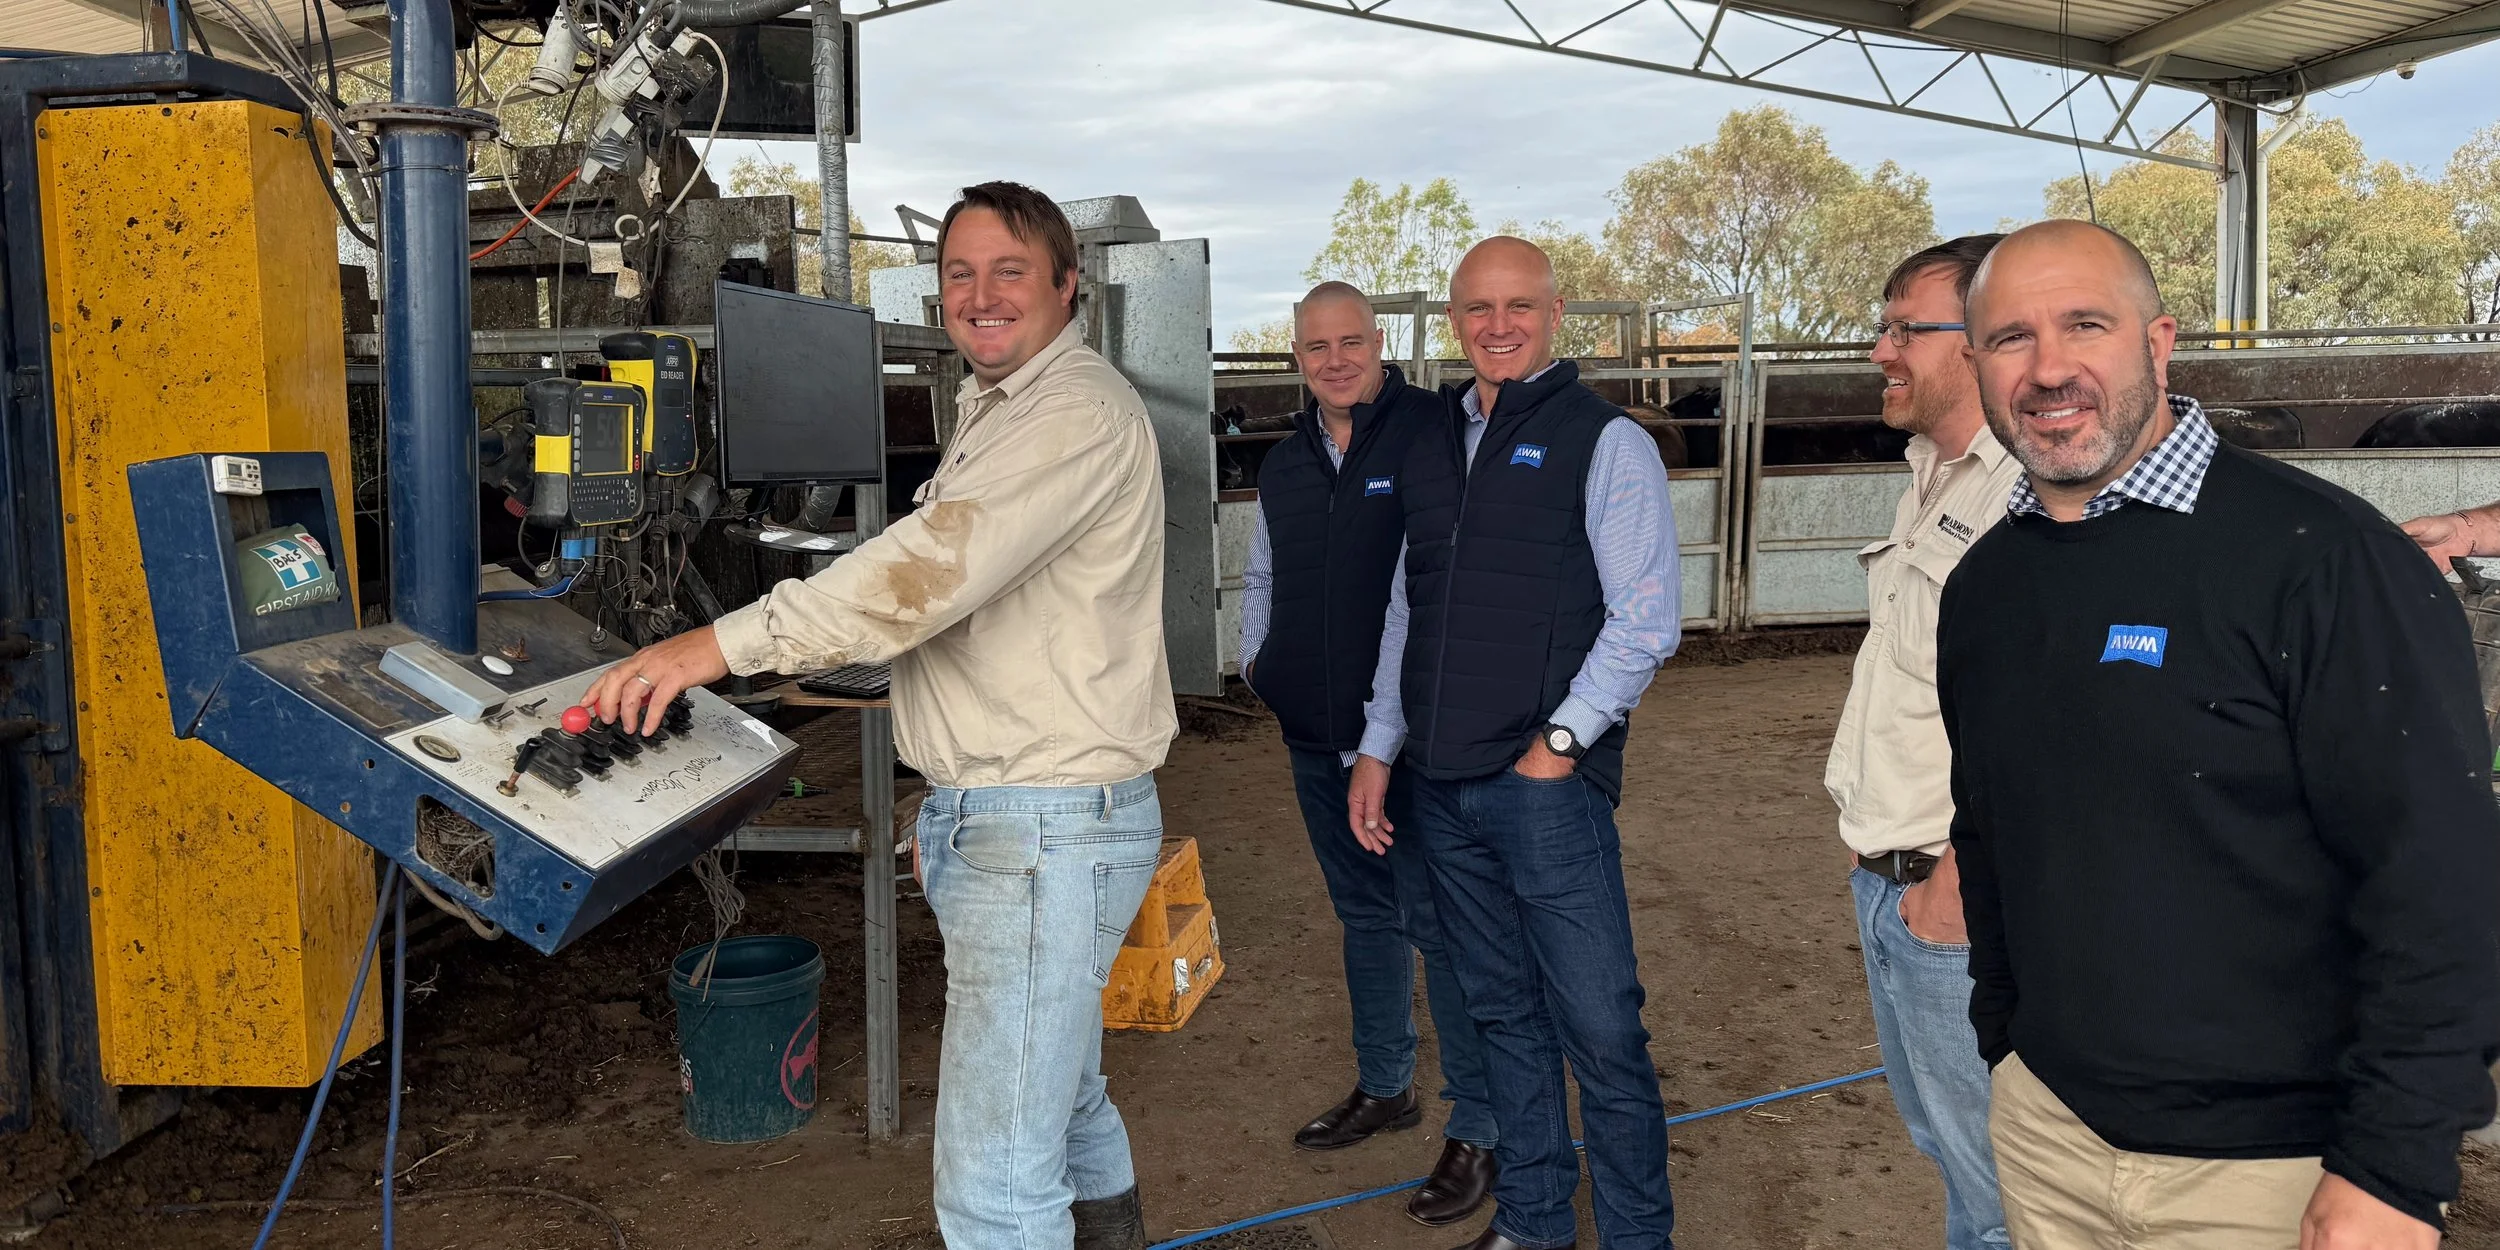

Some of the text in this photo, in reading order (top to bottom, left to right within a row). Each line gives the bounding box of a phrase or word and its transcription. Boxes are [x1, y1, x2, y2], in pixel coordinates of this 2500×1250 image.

[668, 371, 685, 380] READER
[1515, 447, 1541, 460] AWM
[1367, 480, 1391, 490] AWM
[272, 549, 302, 568] BAGS
[256, 593, 301, 616] FIRST
[301, 586, 322, 605] AID
[2110, 634, 2158, 653] AWM
